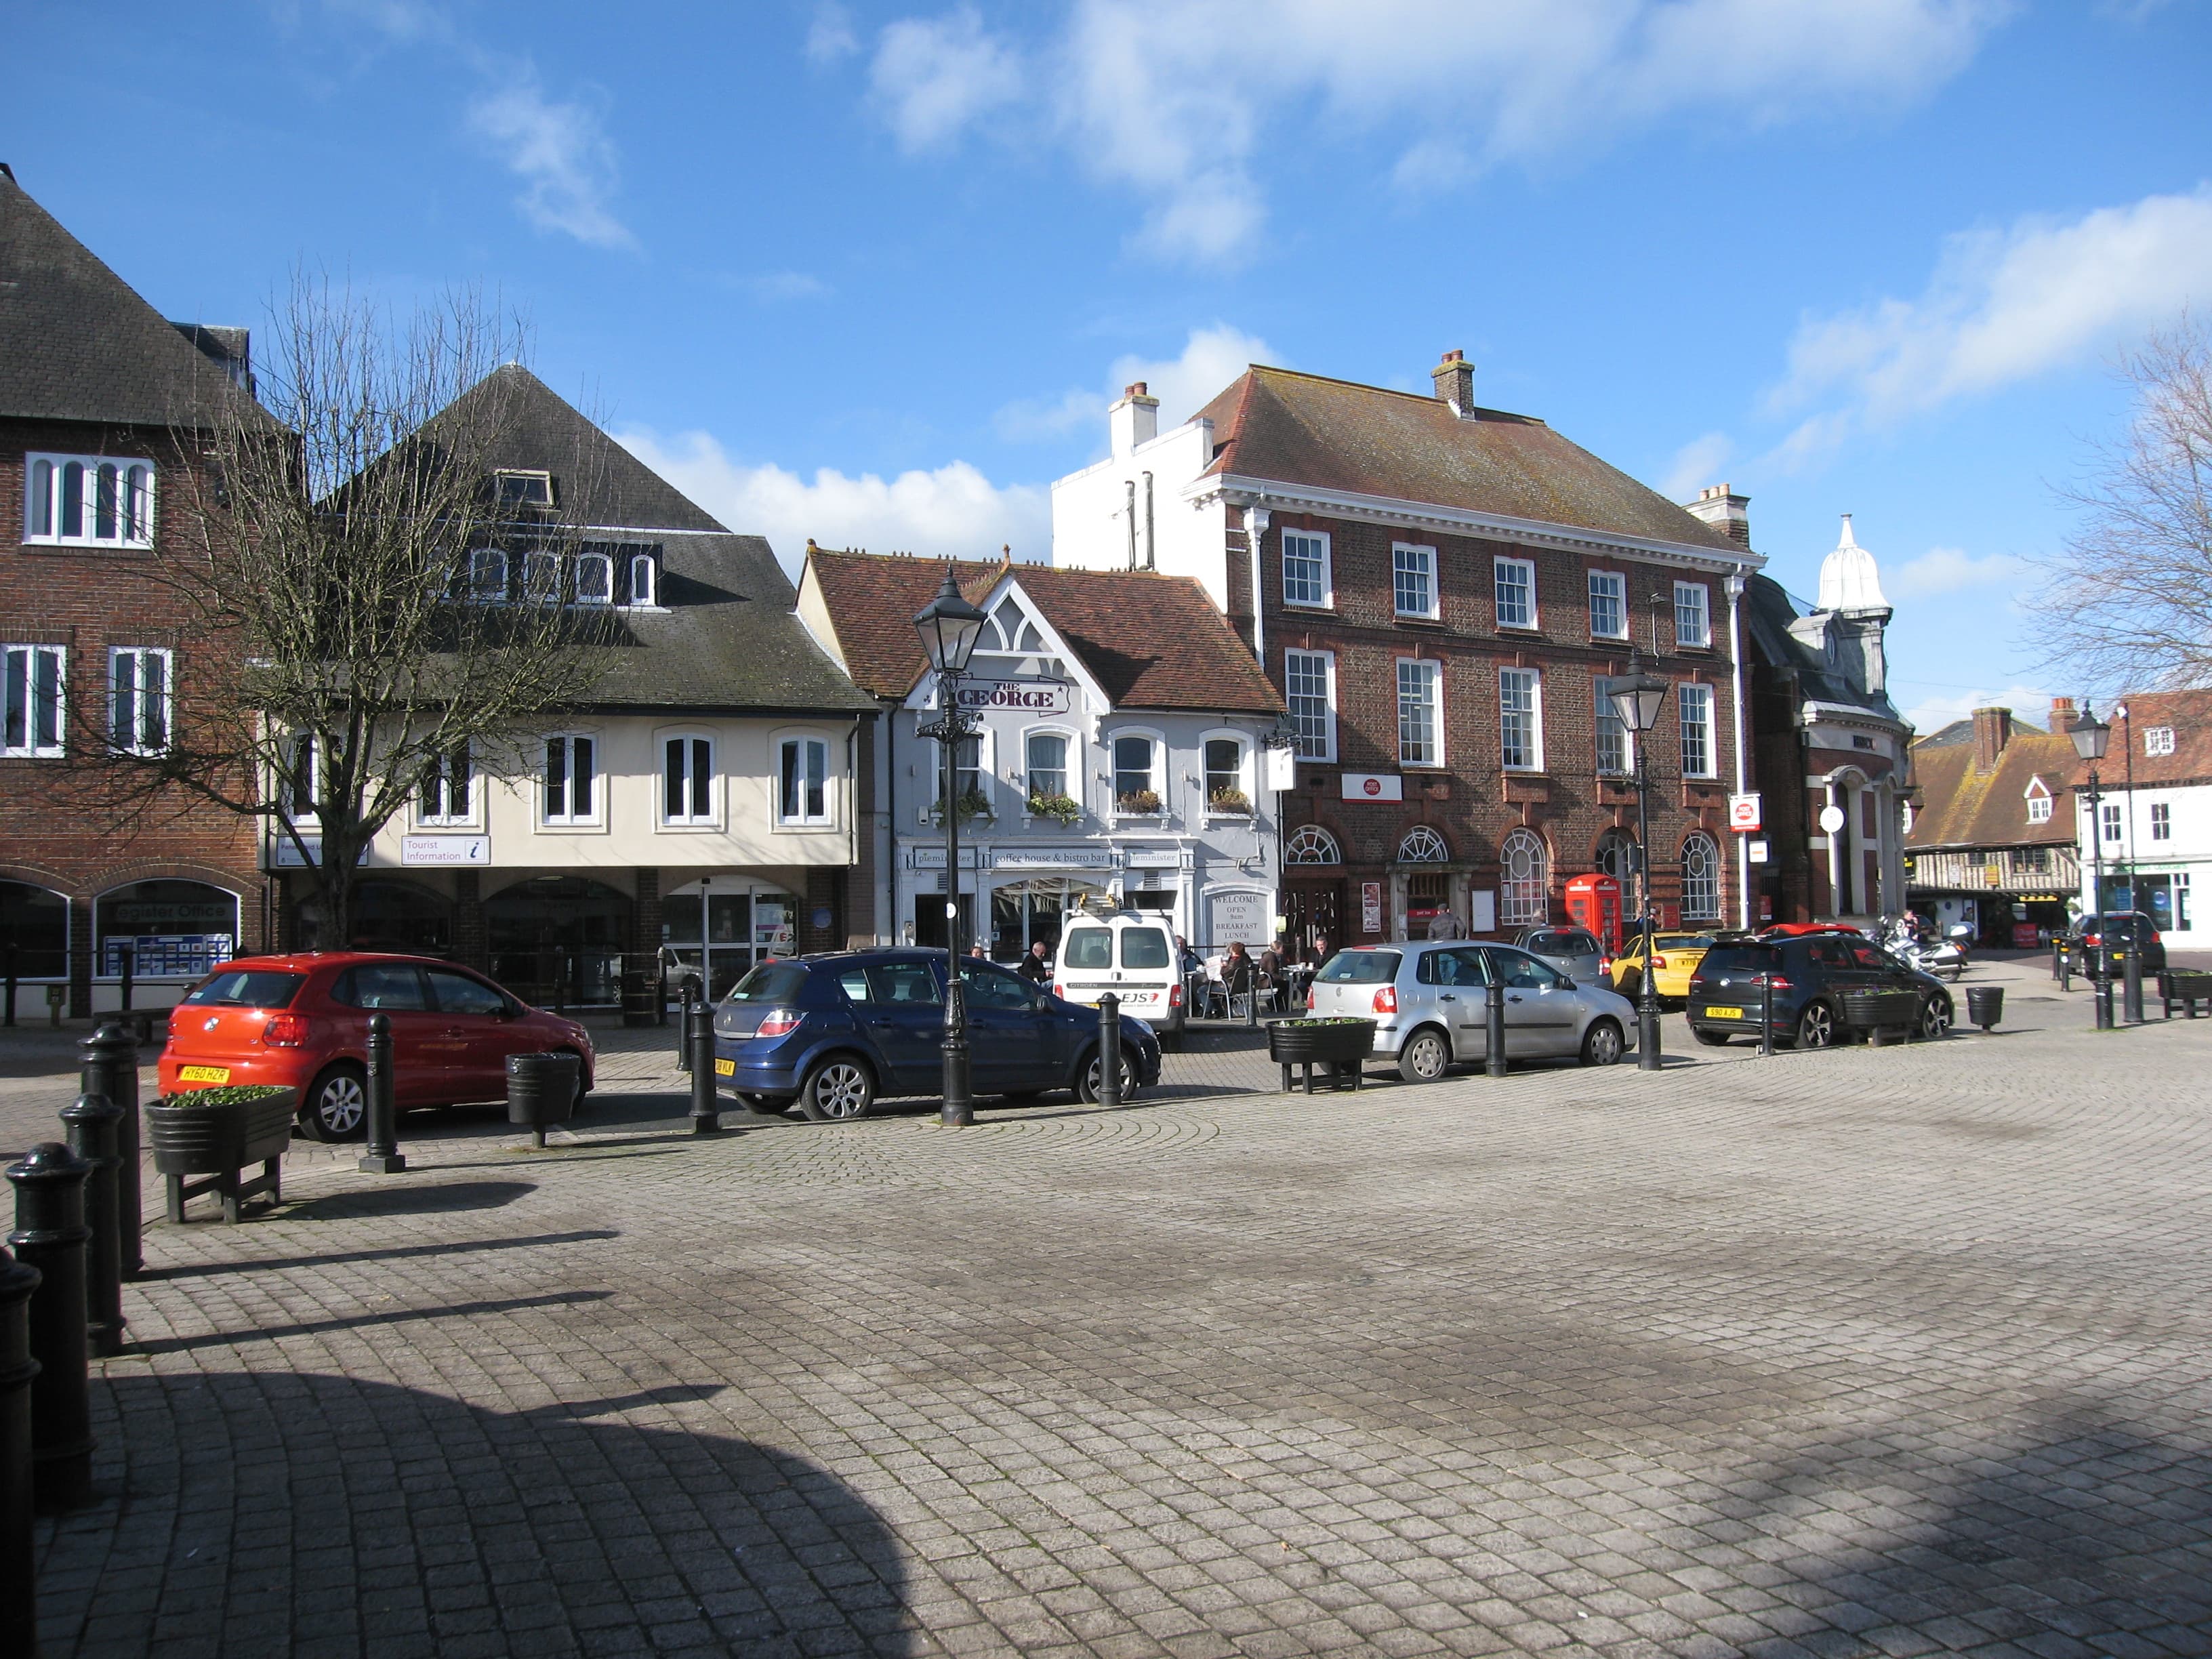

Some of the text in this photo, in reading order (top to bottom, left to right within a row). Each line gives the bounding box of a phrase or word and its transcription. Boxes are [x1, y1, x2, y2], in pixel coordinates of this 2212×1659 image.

[994, 682, 1019, 691] THE
[957, 689, 1053, 707] GEORGE
[407, 840, 438, 849] Tourist
[407, 852, 461, 861] Information
[995, 853, 1106, 863] coffee house & bistro bar
[1128, 853, 1176, 863] pieminister
[1215, 895, 1258, 903] WELCOME
[178, 905, 226, 917] Office
[1122, 993, 1148, 1003] EJS
[184, 1069, 226, 1080] HY60 HZR
